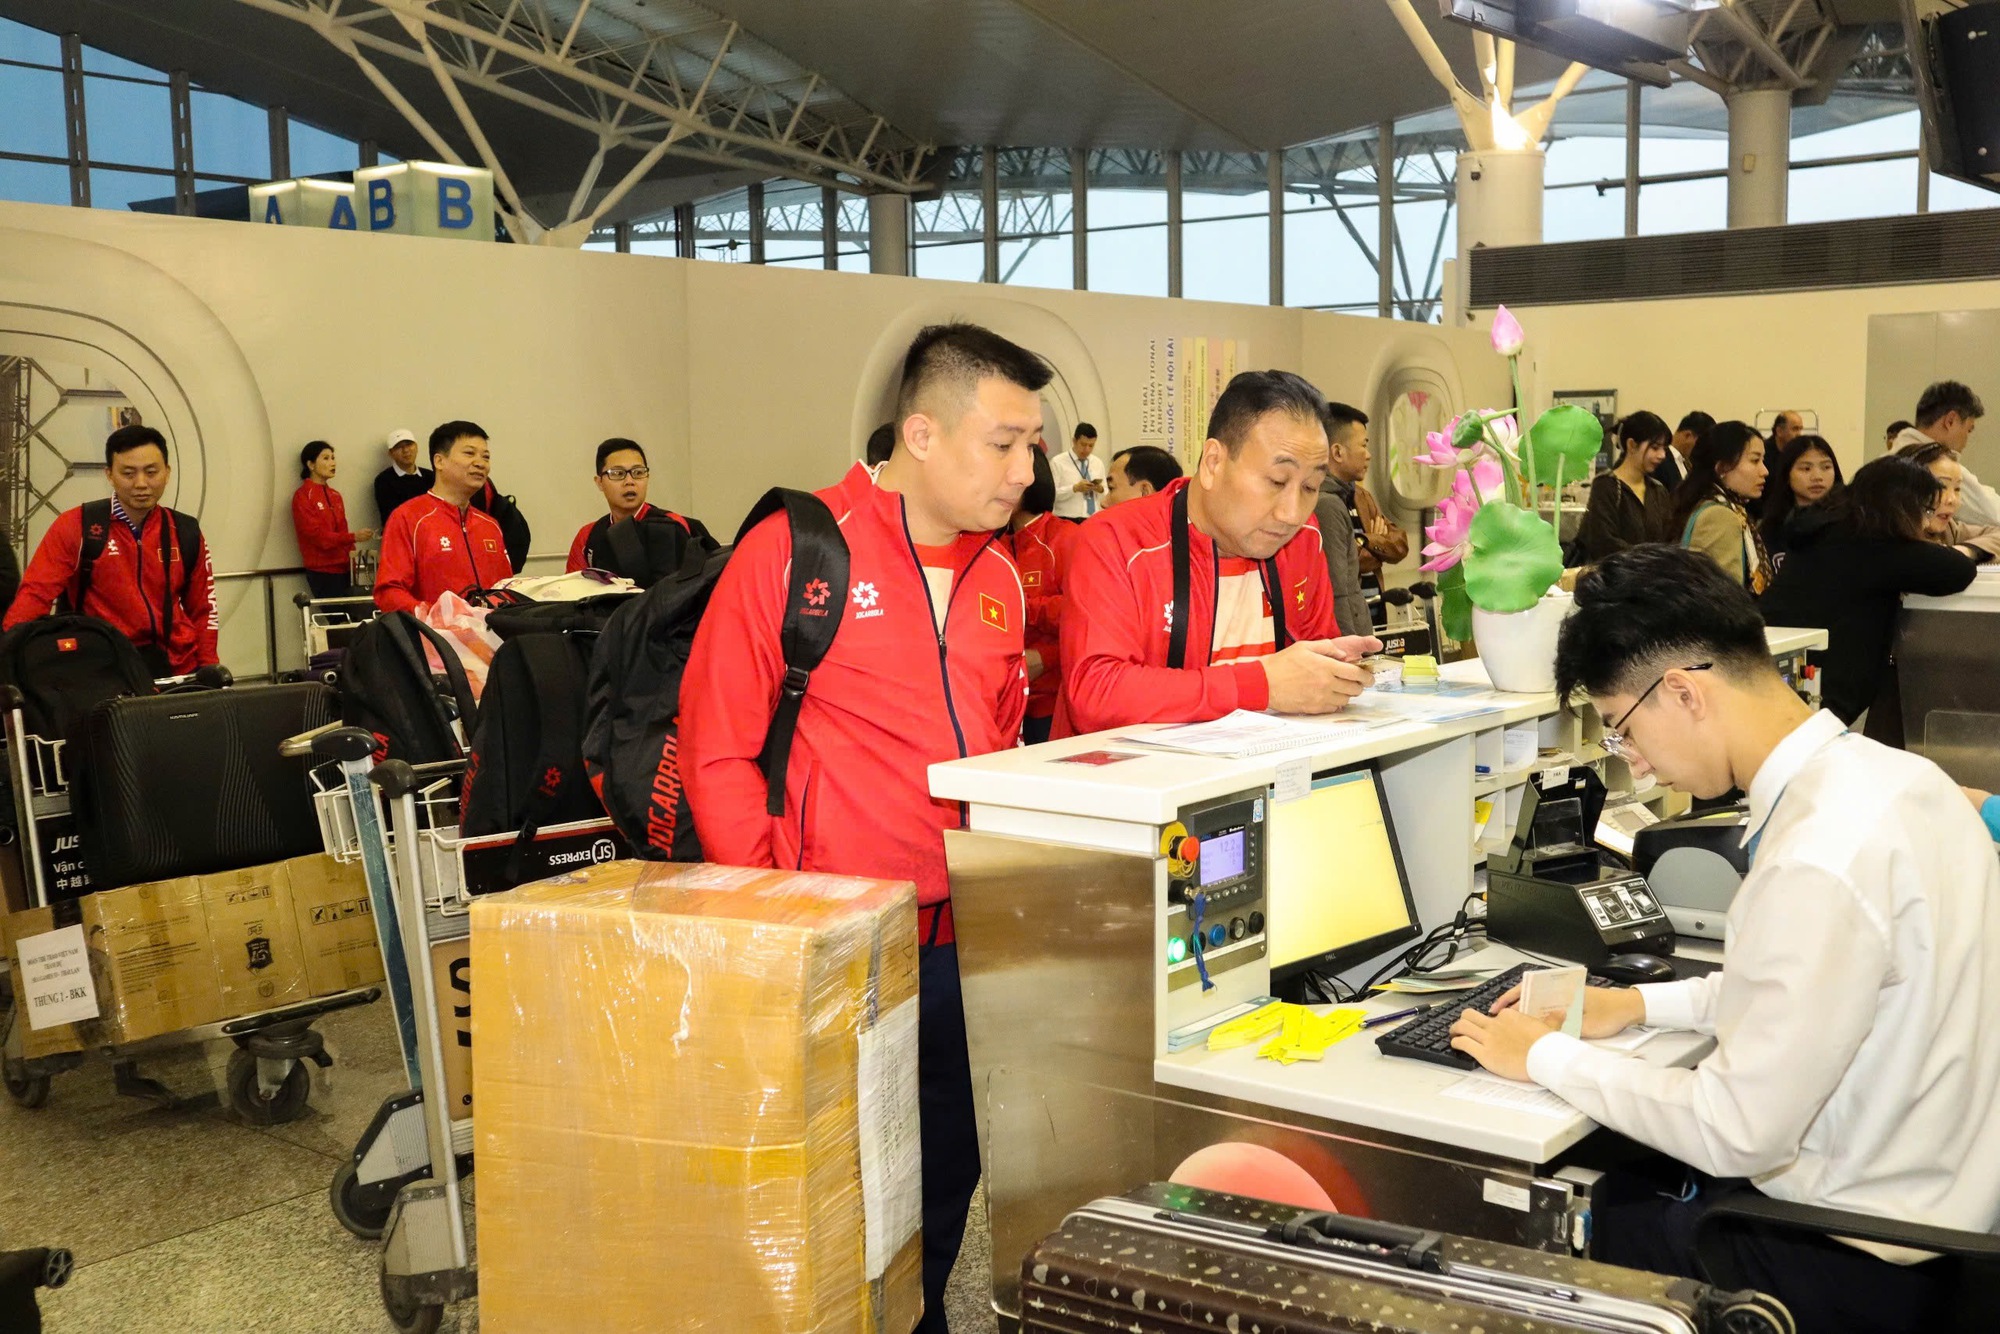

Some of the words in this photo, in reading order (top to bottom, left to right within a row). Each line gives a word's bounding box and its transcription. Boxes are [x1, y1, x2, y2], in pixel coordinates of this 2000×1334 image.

[265, 195, 283, 225] A
[368, 178, 396, 231] B
[437, 177, 474, 229] B
[53, 861, 75, 874] Vận
[548, 850, 591, 866] EXPRESS
[70, 987, 87, 1000] BKK
